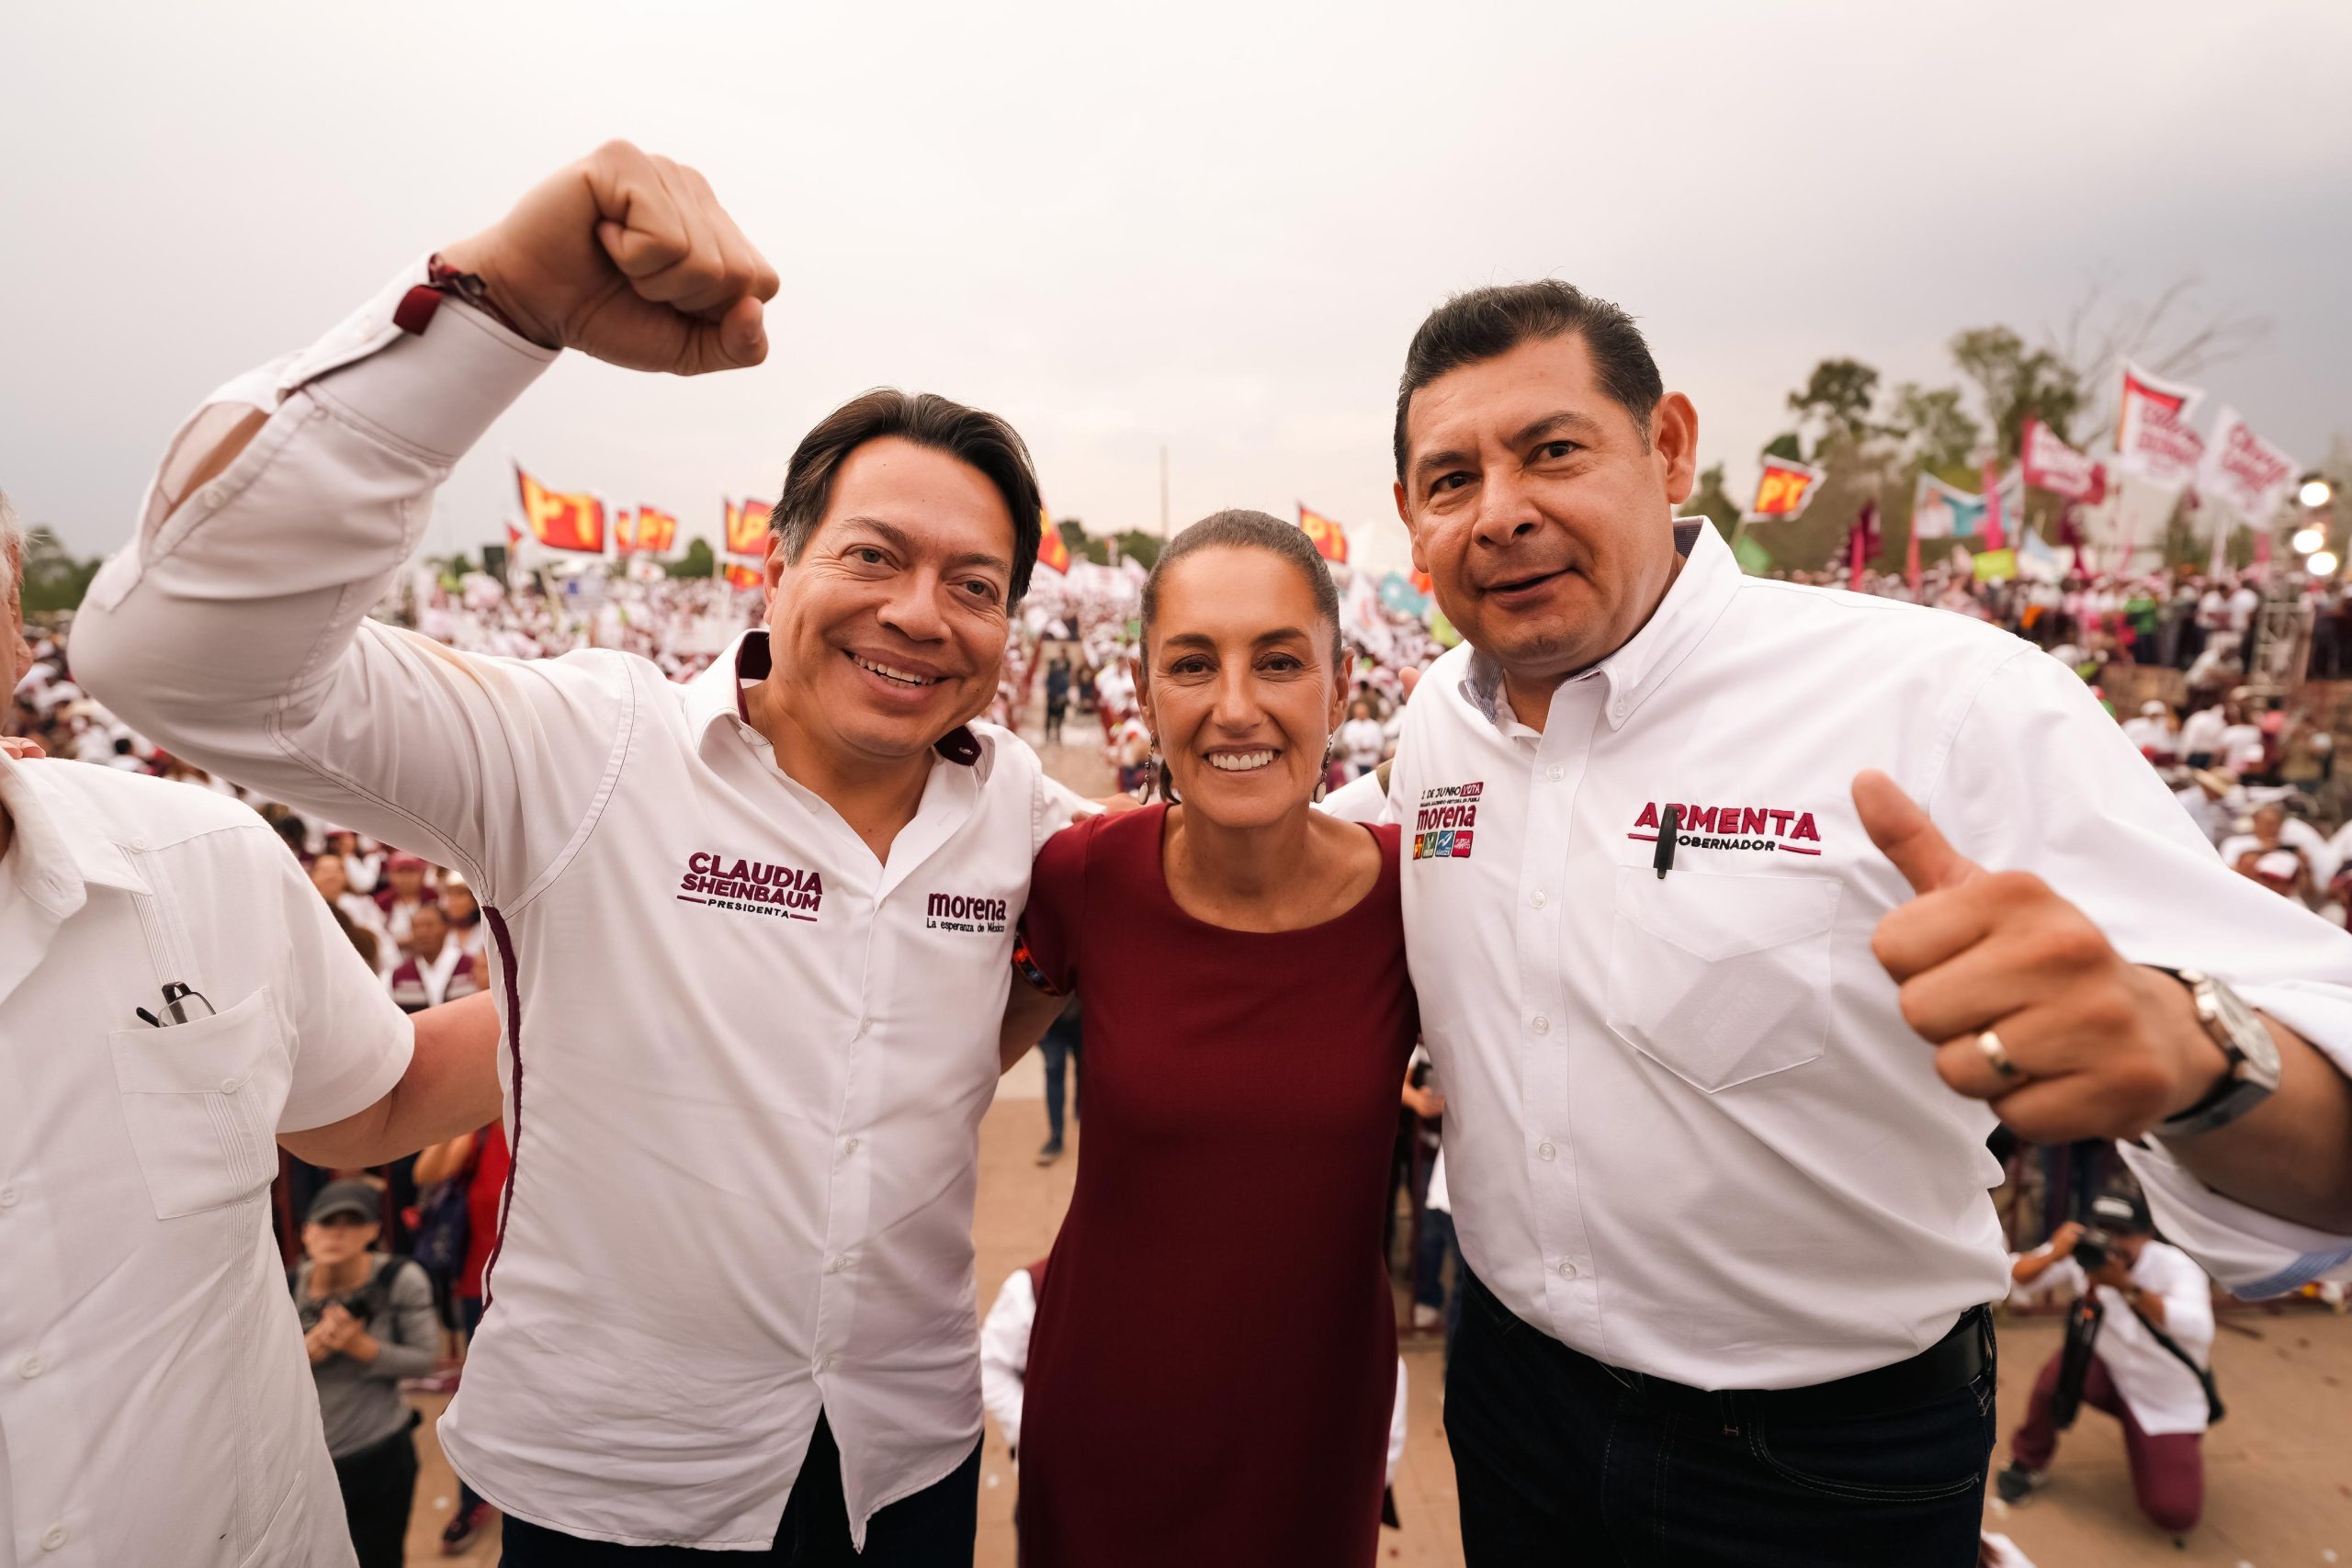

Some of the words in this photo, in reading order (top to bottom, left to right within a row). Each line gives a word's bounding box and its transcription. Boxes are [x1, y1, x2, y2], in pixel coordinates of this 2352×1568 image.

[1757, 475, 1809, 513] PT
[521, 475, 595, 544] PT
[1427, 789, 1435, 798] DE
[1435, 786, 1461, 797] JUNIO
[1463, 784, 1480, 795] VOTA
[1417, 805, 1476, 830] morena
[1634, 802, 1821, 841] ARMENTA
[1676, 835, 1775, 851] OBERNADOR
[688, 852, 823, 895] CLAUDIA
[681, 874, 821, 912] SHEINBAUM
[927, 893, 1006, 920] morena
[707, 898, 789, 919] PRESIDENTA
[926, 918, 936, 928] La
[941, 920, 974, 932] esperanza
[978, 923, 984, 931] de
